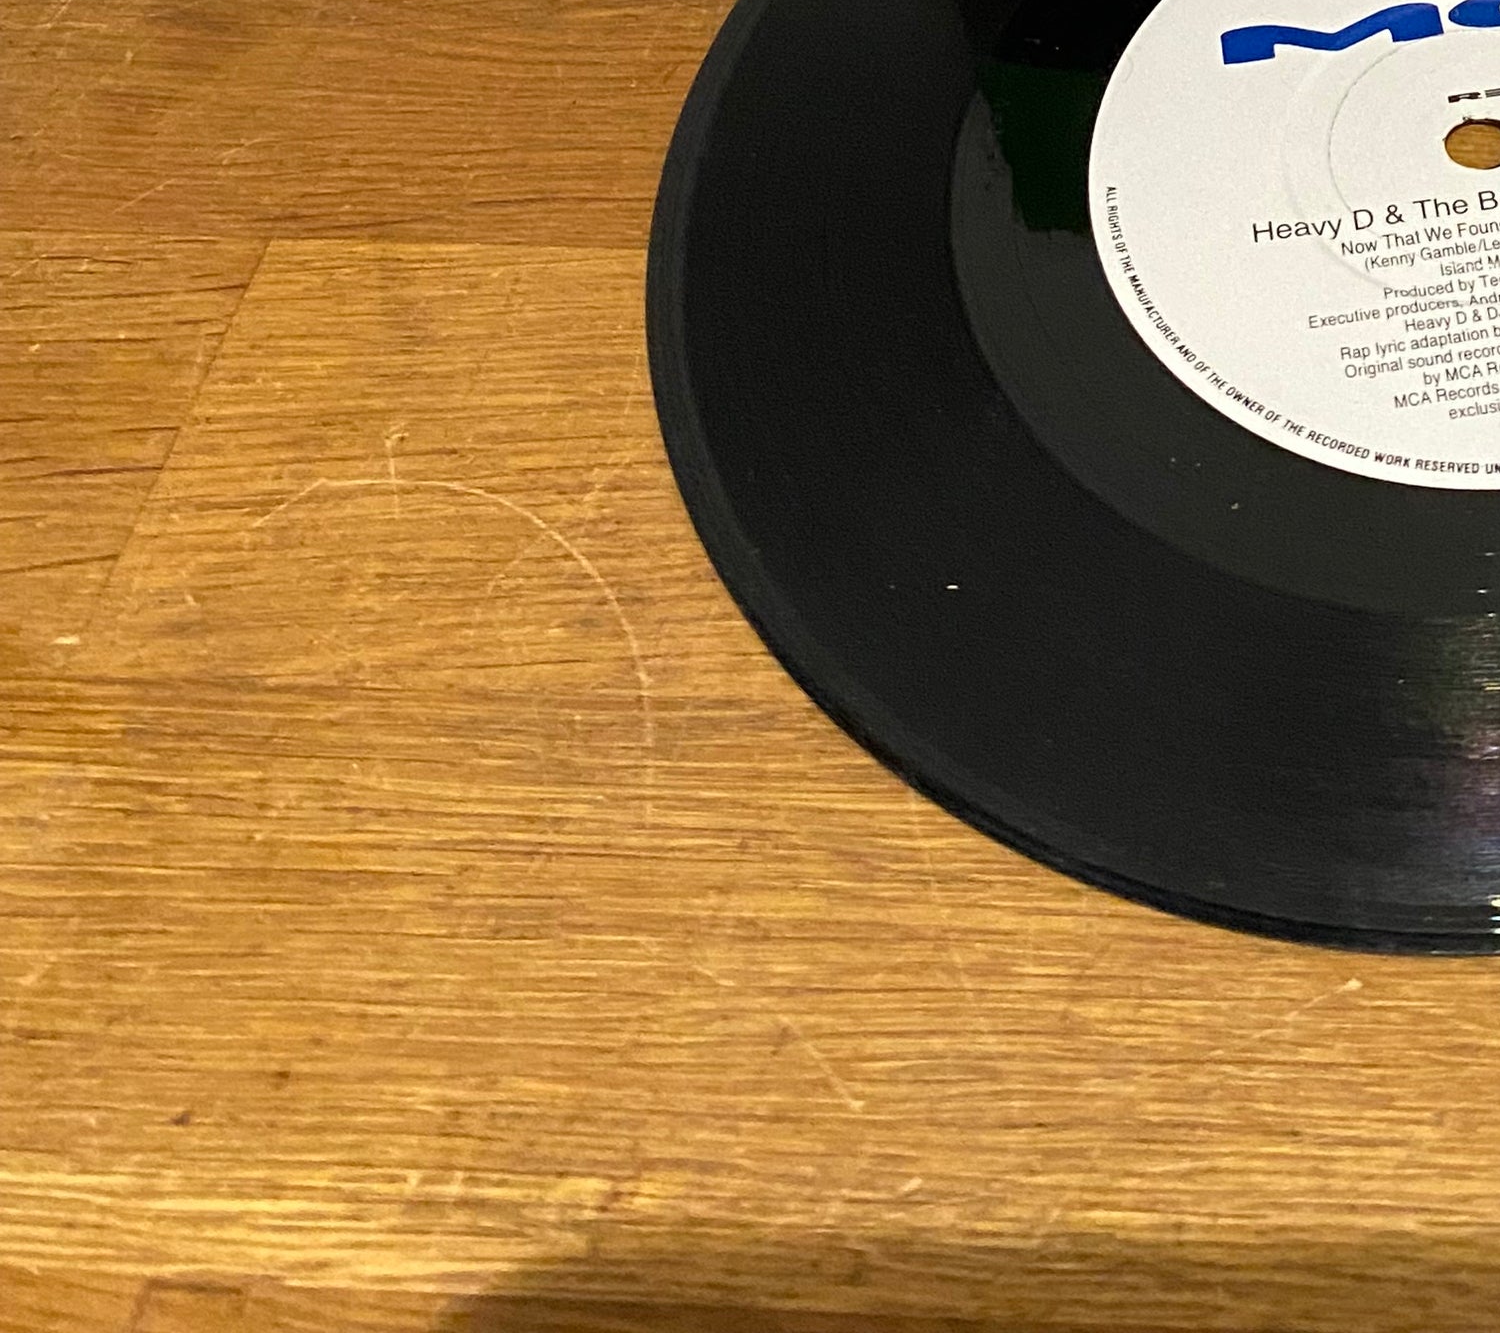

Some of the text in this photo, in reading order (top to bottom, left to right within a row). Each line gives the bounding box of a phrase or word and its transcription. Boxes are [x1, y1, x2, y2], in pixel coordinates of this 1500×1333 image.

[1106, 186, 1117, 202] ALL
[1107, 205, 1123, 241] RIGHTS
[1252, 217, 1342, 243] Heavy
[1353, 209, 1374, 231] D
[1385, 204, 1405, 225] &
[1412, 198, 1469, 219] The
[1115, 241, 1128, 255] OF
[1341, 240, 1378, 256] Now
[1382, 230, 1421, 249] That
[1424, 226, 1453, 242] We
[1119, 254, 1135, 274] THE
[1364, 252, 1416, 272] (Kenny
[1440, 258, 1484, 277] Island
[1383, 279, 1454, 299] Produced
[1458, 279, 1475, 294] by
[1128, 274, 1181, 345] MANUFACTURER
[1308, 308, 1381, 329] Executive
[1405, 317, 1451, 332] Heavy
[1456, 311, 1467, 325] D
[1472, 309, 1482, 322] &
[1176, 344, 1197, 364] AND
[1340, 346, 1371, 360] Rap
[1375, 340, 1406, 358] lyric
[1410, 328, 1489, 350] adaptation
[1194, 361, 1211, 374] OF
[1344, 356, 1404, 379] Original
[1408, 350, 1453, 369] sound
[1206, 371, 1228, 391] THE
[1423, 372, 1440, 387] by
[1445, 364, 1483, 382] MCA
[1225, 386, 1265, 416] OWNER
[1394, 391, 1432, 408] MCA
[1436, 382, 1499, 402] Records
[1264, 410, 1282, 423] OF
[1282, 418, 1306, 437] THE
[1306, 430, 1370, 459] RECORDED
[1374, 452, 1411, 468] WORK
[1415, 459, 1480, 474] RESERVED
